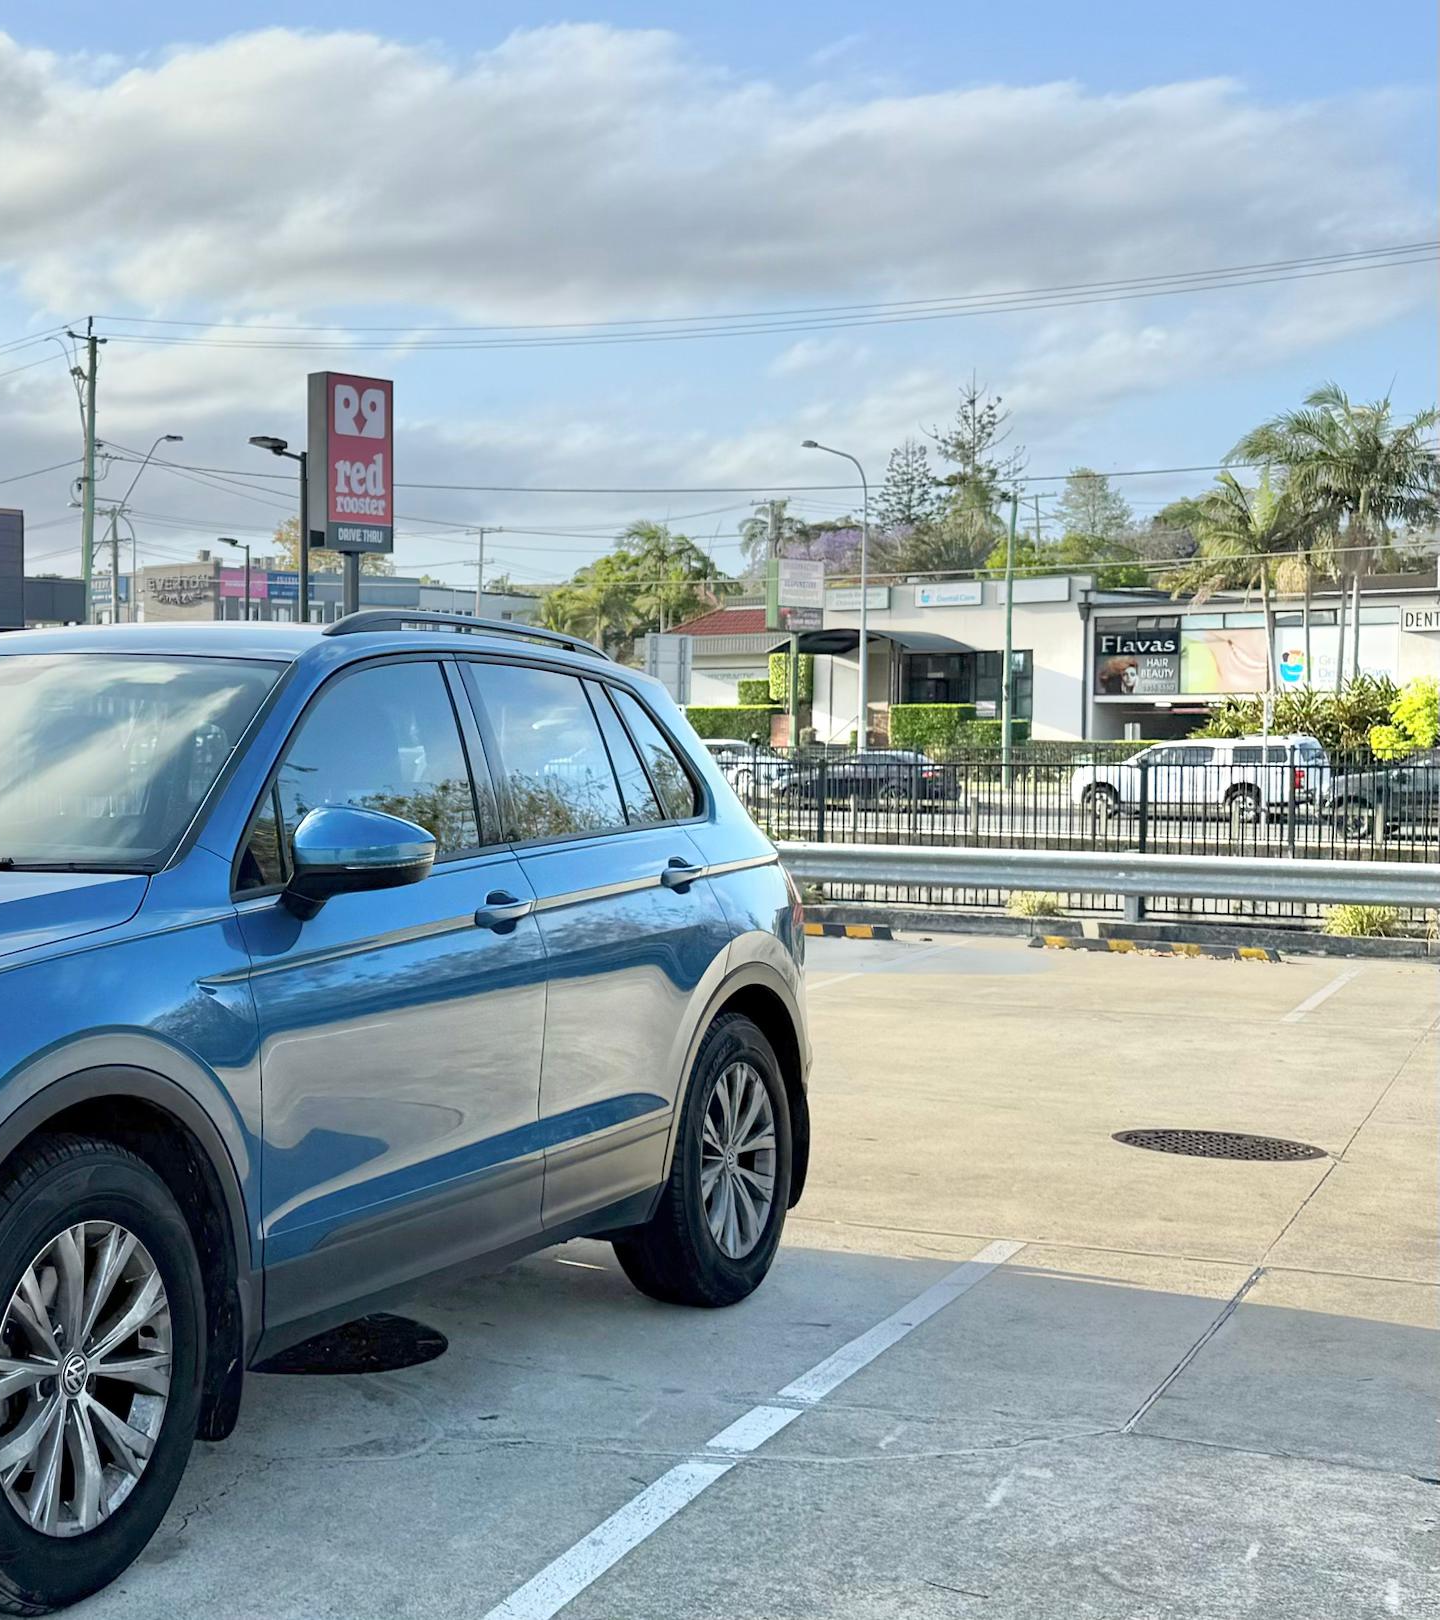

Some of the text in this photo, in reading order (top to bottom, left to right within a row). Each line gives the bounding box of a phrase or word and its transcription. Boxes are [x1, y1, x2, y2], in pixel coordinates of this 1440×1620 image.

[335, 453, 386, 497] red
[335, 496, 386, 517] rooster
[338, 527, 383, 544] DRIVE THRU
[1101, 635, 1176, 653] Flavas
[1146, 658, 1169, 668] HAIR
[1141, 668, 1174, 679] BEAUTY
